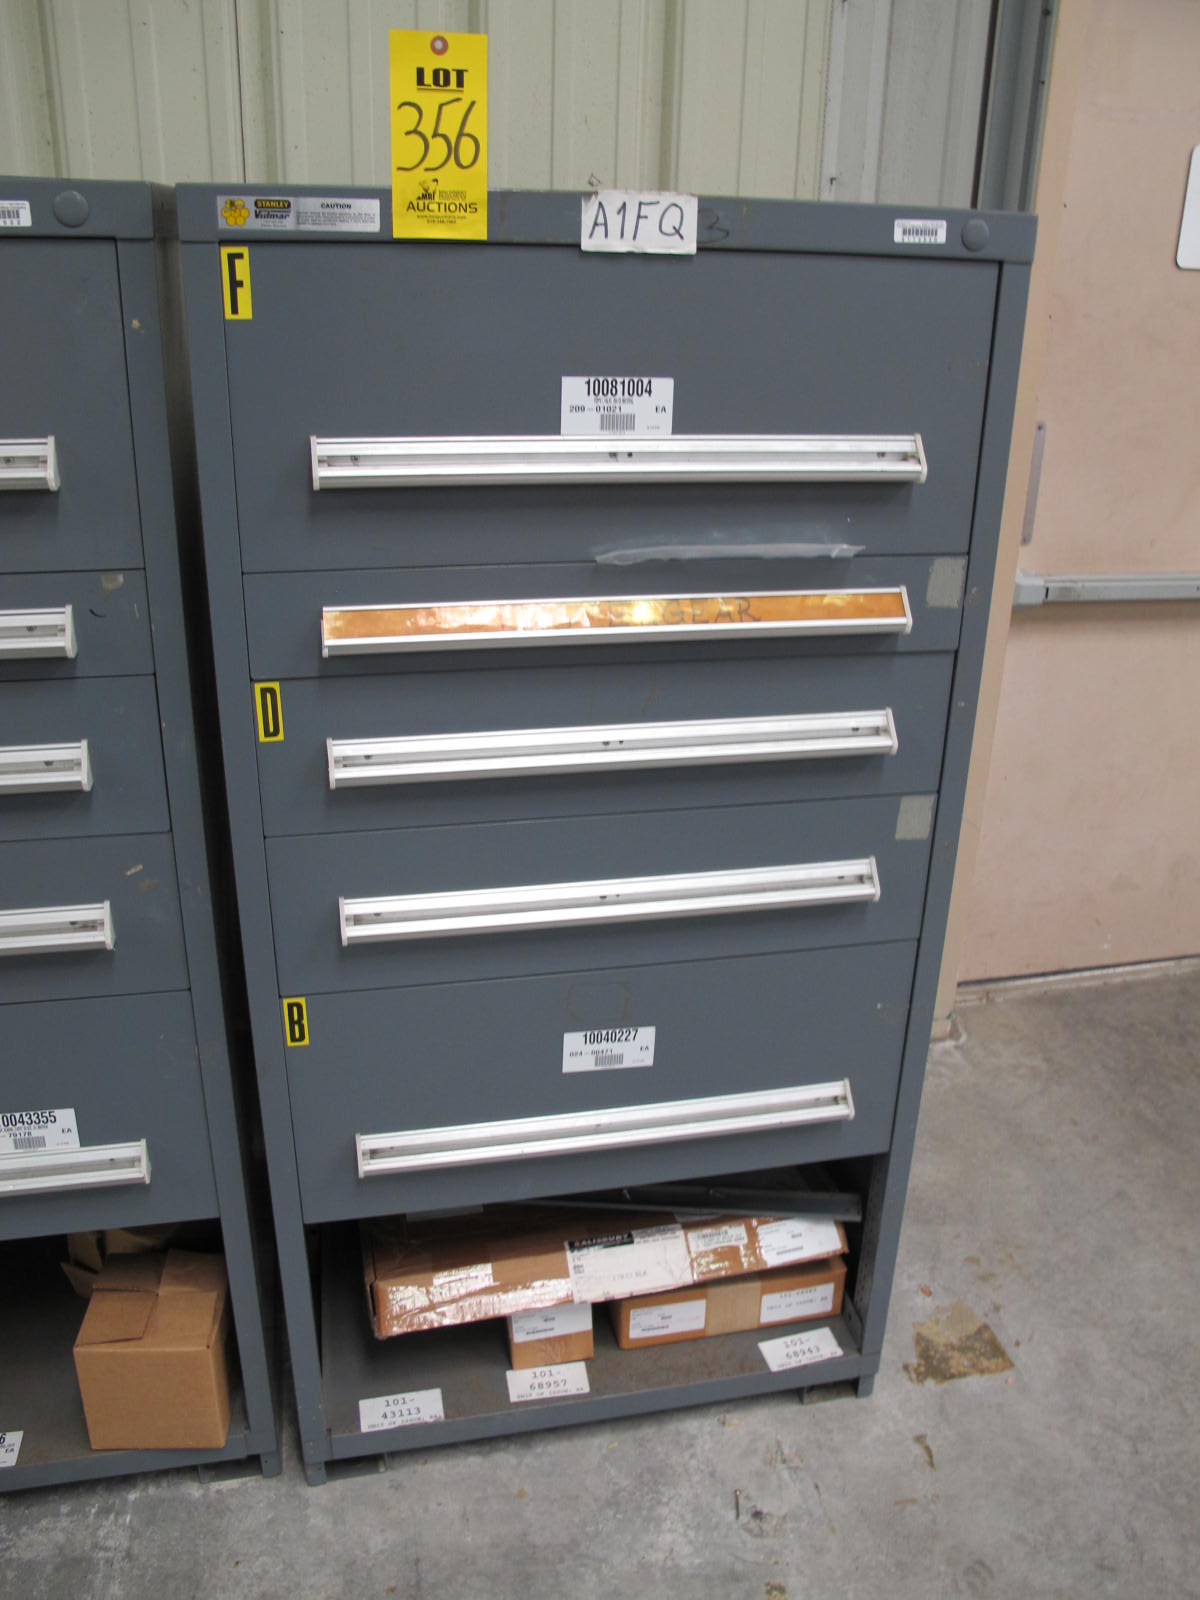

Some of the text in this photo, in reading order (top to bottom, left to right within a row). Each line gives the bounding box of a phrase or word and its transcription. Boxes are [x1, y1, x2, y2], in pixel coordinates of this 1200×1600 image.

[416, 66, 469, 88] LOT
[396, 97, 481, 172] 356
[256, 200, 289, 209] STANLEY
[406, 201, 478, 214] AUCTIONS
[589, 200, 685, 240] A1FQ
[227, 253, 244, 315] F
[585, 378, 653, 397] 10081004
[260, 687, 281, 738] D
[287, 1002, 306, 1042] B
[583, 1028, 639, 1045] 10040227
[381, 1407, 421, 1419] 43113
